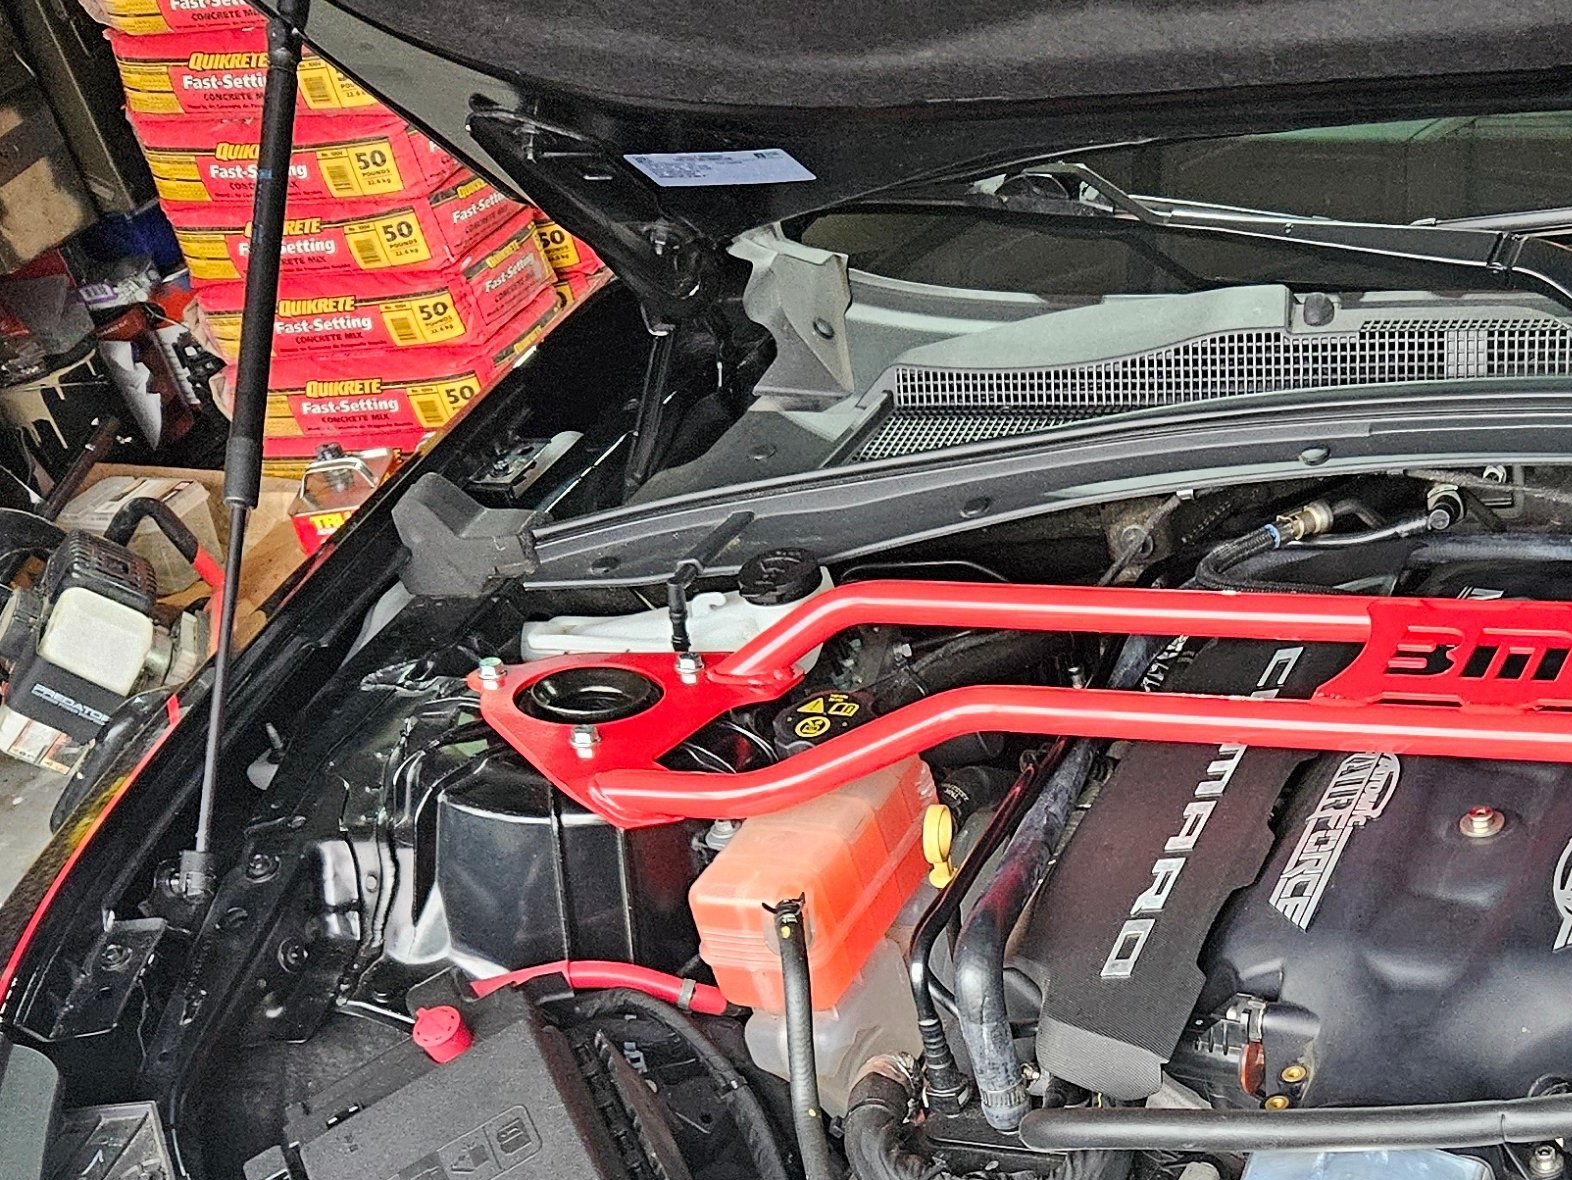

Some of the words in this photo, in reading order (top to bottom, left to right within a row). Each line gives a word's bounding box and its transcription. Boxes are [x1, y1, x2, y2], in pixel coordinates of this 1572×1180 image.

[188, 51, 267, 70] QUIKRETE
[182, 74, 266, 91] Fast-Setti
[356, 149, 387, 170] 50
[382, 221, 413, 243] 50
[278, 295, 356, 318] QUIKRETE
[418, 301, 449, 321] 50
[275, 316, 372, 335] Fast-Setting
[296, 333, 342, 345] CONCRETE
[345, 331, 363, 341] MIX
[305, 378, 382, 398] QUIKRETE
[445, 384, 475, 405] 50
[301, 397, 399, 416] Fast-Setting
[321, 414, 369, 423] CONCRETE
[371, 413, 390, 421] MIX
